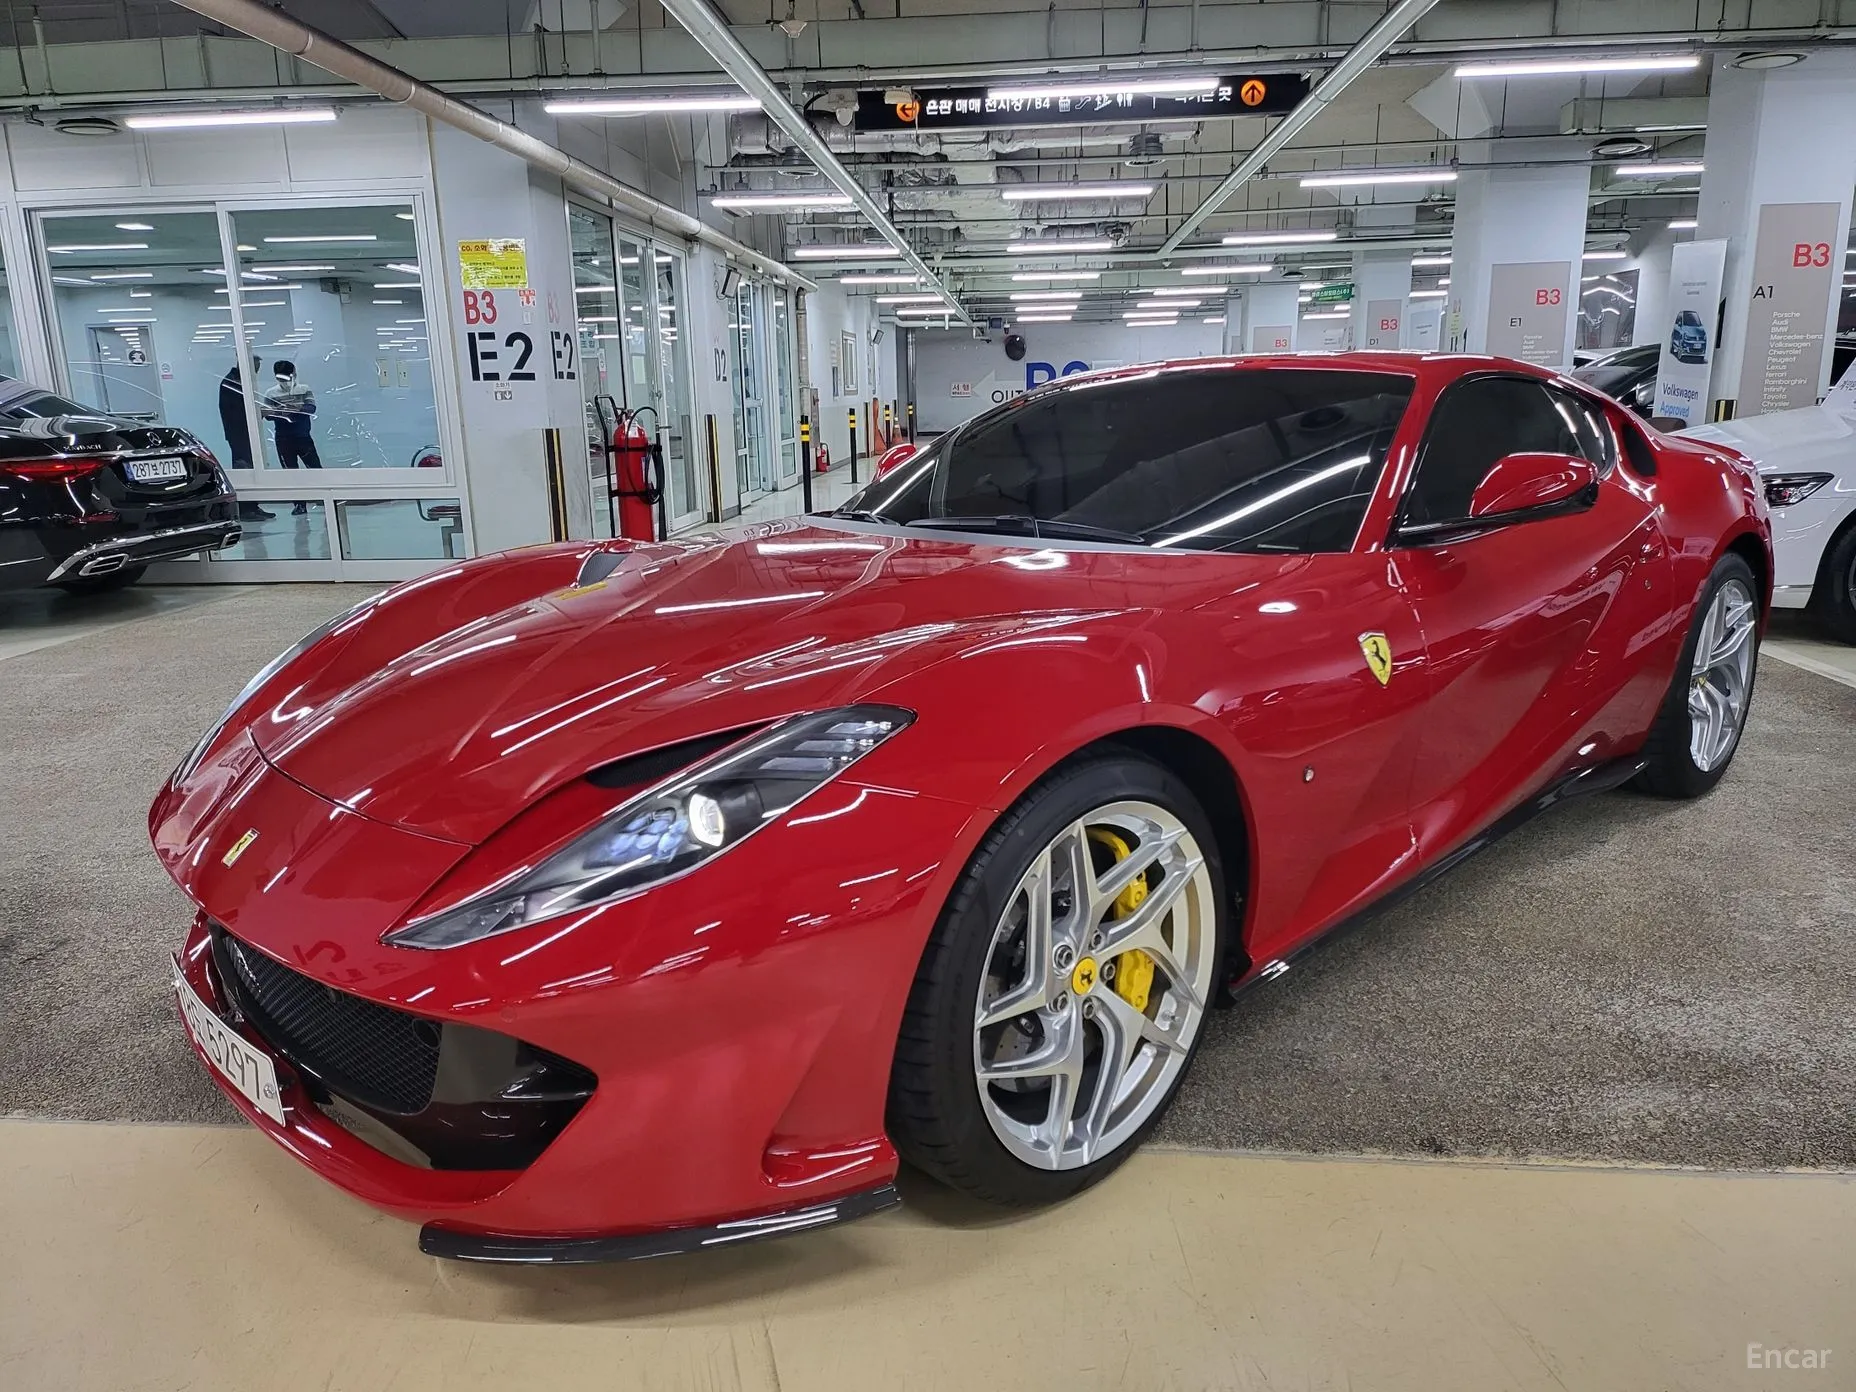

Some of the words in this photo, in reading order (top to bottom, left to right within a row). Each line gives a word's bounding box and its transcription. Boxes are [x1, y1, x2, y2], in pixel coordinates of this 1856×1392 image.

[956, 98, 981, 114] 매매
[1792, 242, 1830, 268] B3
[1536, 288, 1561, 305] B3
[1753, 286, 1774, 299] A1
[463, 290, 497, 324] B3
[1381, 318, 1398, 331] B3
[1510, 317, 1522, 327] E1
[1275, 339, 1288, 348] B3
[467, 332, 536, 381] E2
[551, 331, 575, 380] E2
[714, 348, 728, 382] D2
[1663, 383, 1699, 402] Volkswagen
[1660, 401, 1690, 418] Approved
